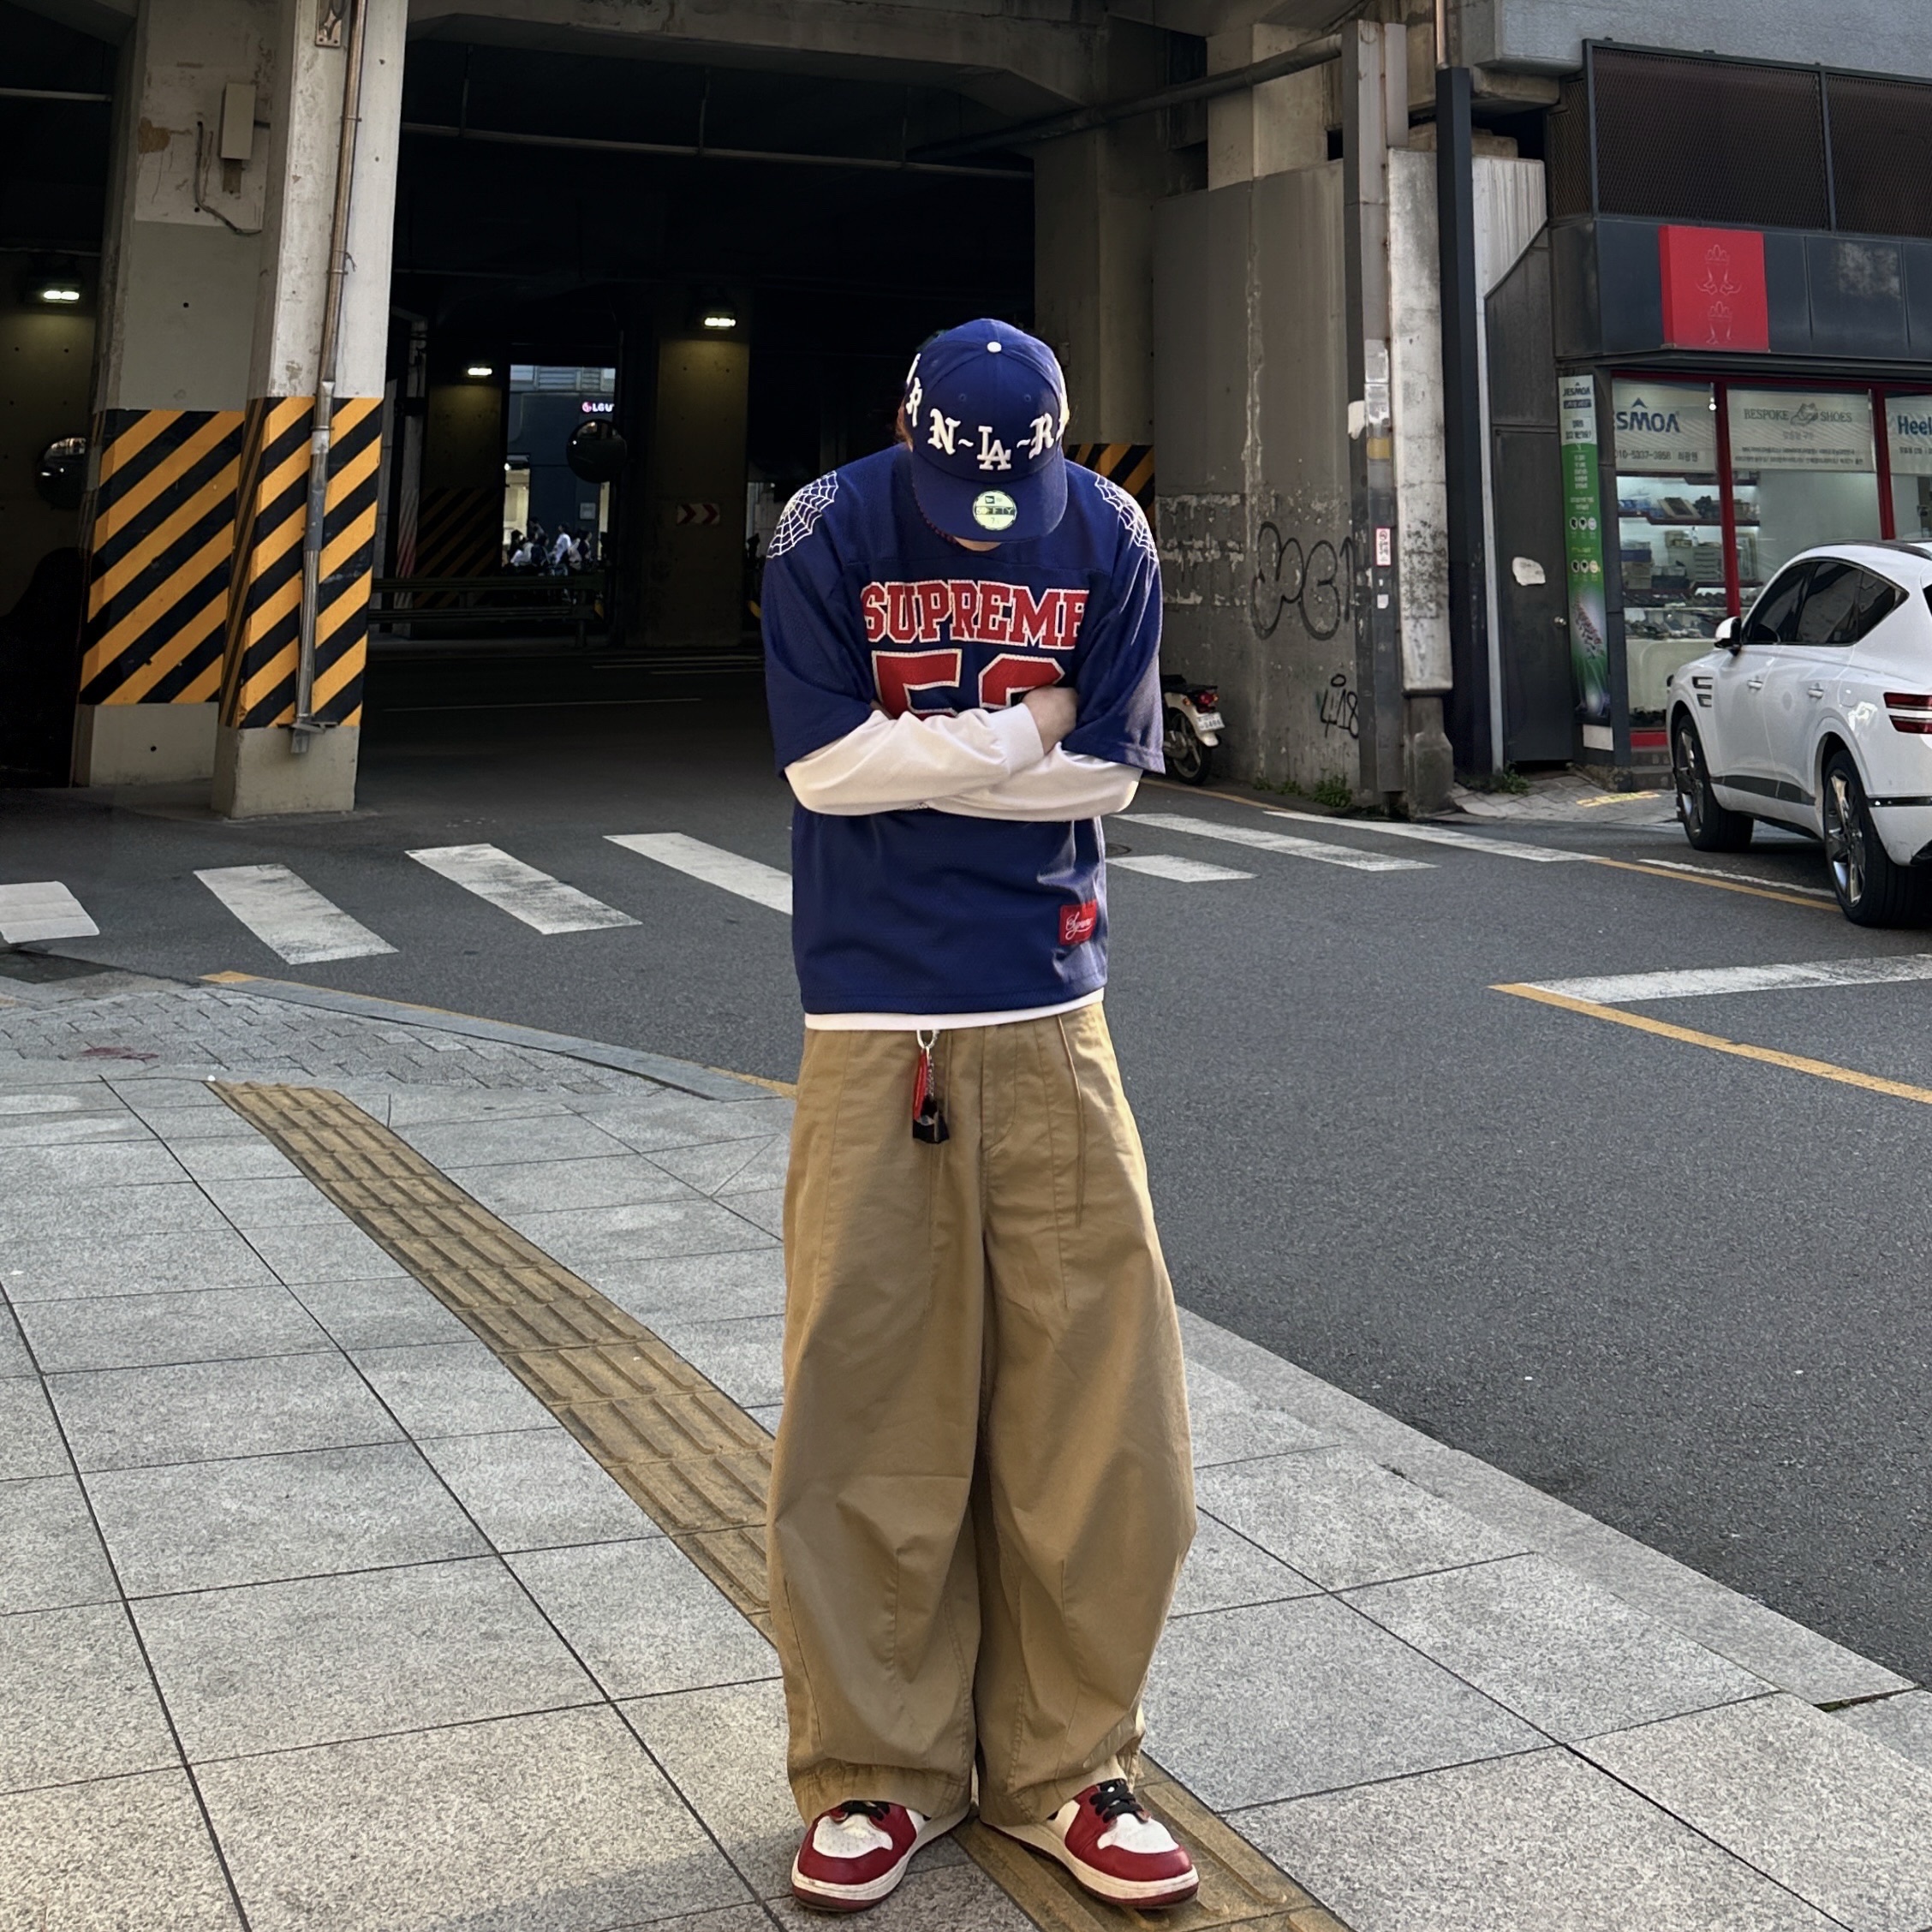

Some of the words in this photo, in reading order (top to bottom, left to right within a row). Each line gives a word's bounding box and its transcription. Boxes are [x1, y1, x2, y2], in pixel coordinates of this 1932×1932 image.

[1744, 408, 1789, 420] BESPOKE
[1820, 411, 1852, 423] SHOES
[861, 579, 1089, 650] SUPREME
